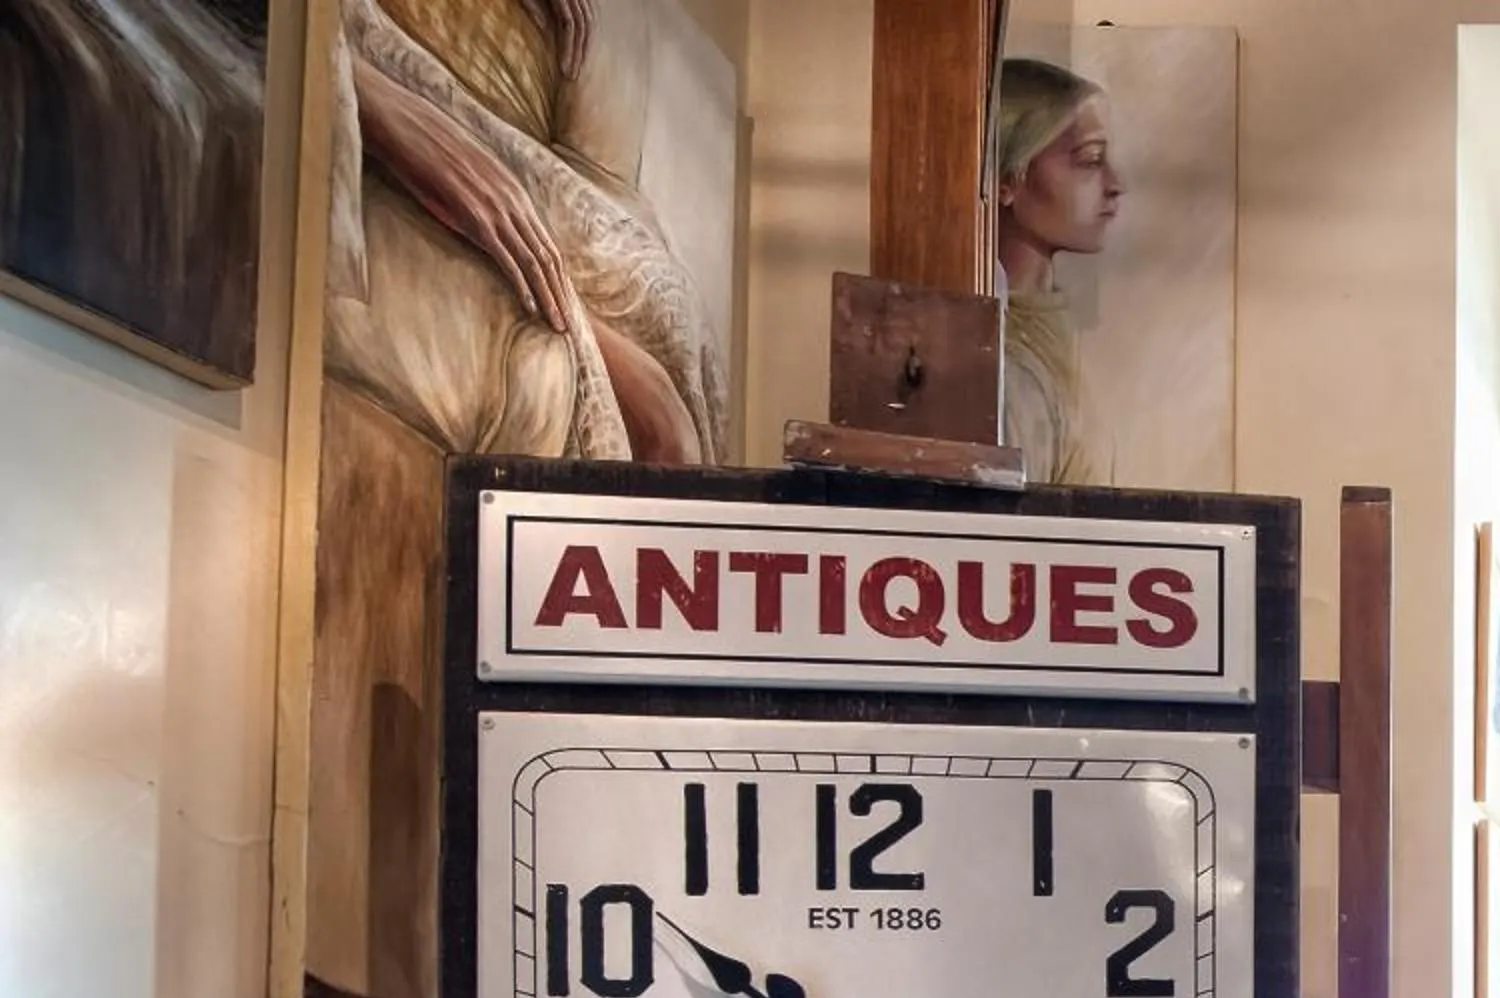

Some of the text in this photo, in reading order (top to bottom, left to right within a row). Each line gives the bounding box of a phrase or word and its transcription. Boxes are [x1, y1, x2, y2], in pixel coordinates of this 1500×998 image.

[534, 544, 1199, 649] ANTIQUES
[684, 782, 759, 896] 11
[816, 783, 924, 890] 12
[1033, 789, 1053, 896] 1
[546, 884, 654, 998] 10
[809, 908, 941, 930] EST 1886
[1105, 890, 1174, 998] 2
